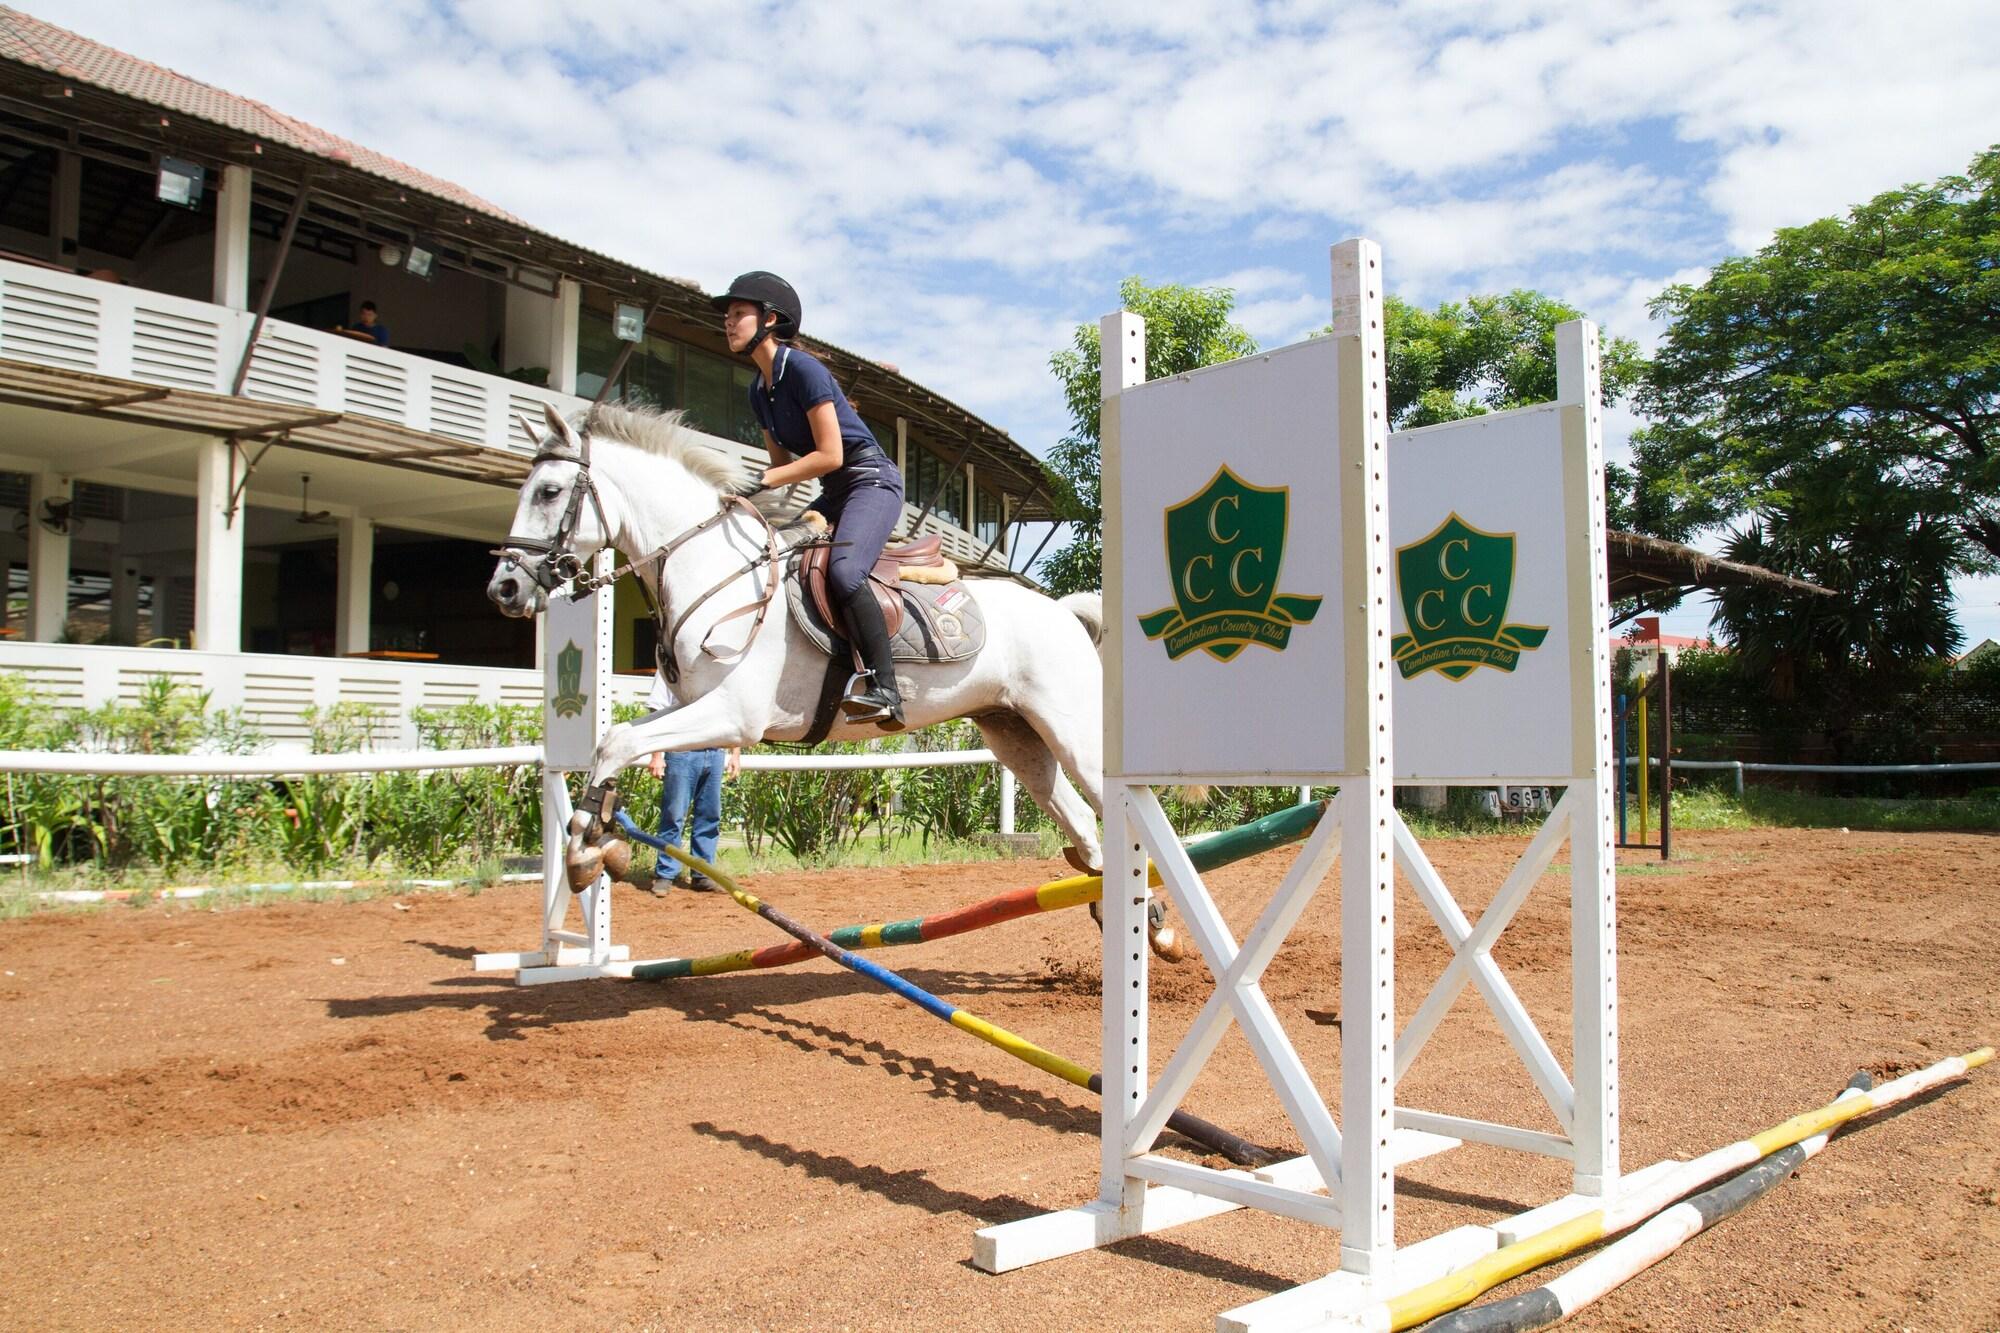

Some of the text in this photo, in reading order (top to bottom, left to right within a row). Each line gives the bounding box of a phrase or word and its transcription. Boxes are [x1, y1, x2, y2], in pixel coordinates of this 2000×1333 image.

[1207, 494, 1240, 544] C
[1438, 538, 1470, 581] C
[1170, 618, 1285, 650] Cambodian Country Club
[1403, 644, 1514, 671] Cambodian Country Club
[1510, 792, 1520, 807] S
[1525, 791, 1532, 806] S
